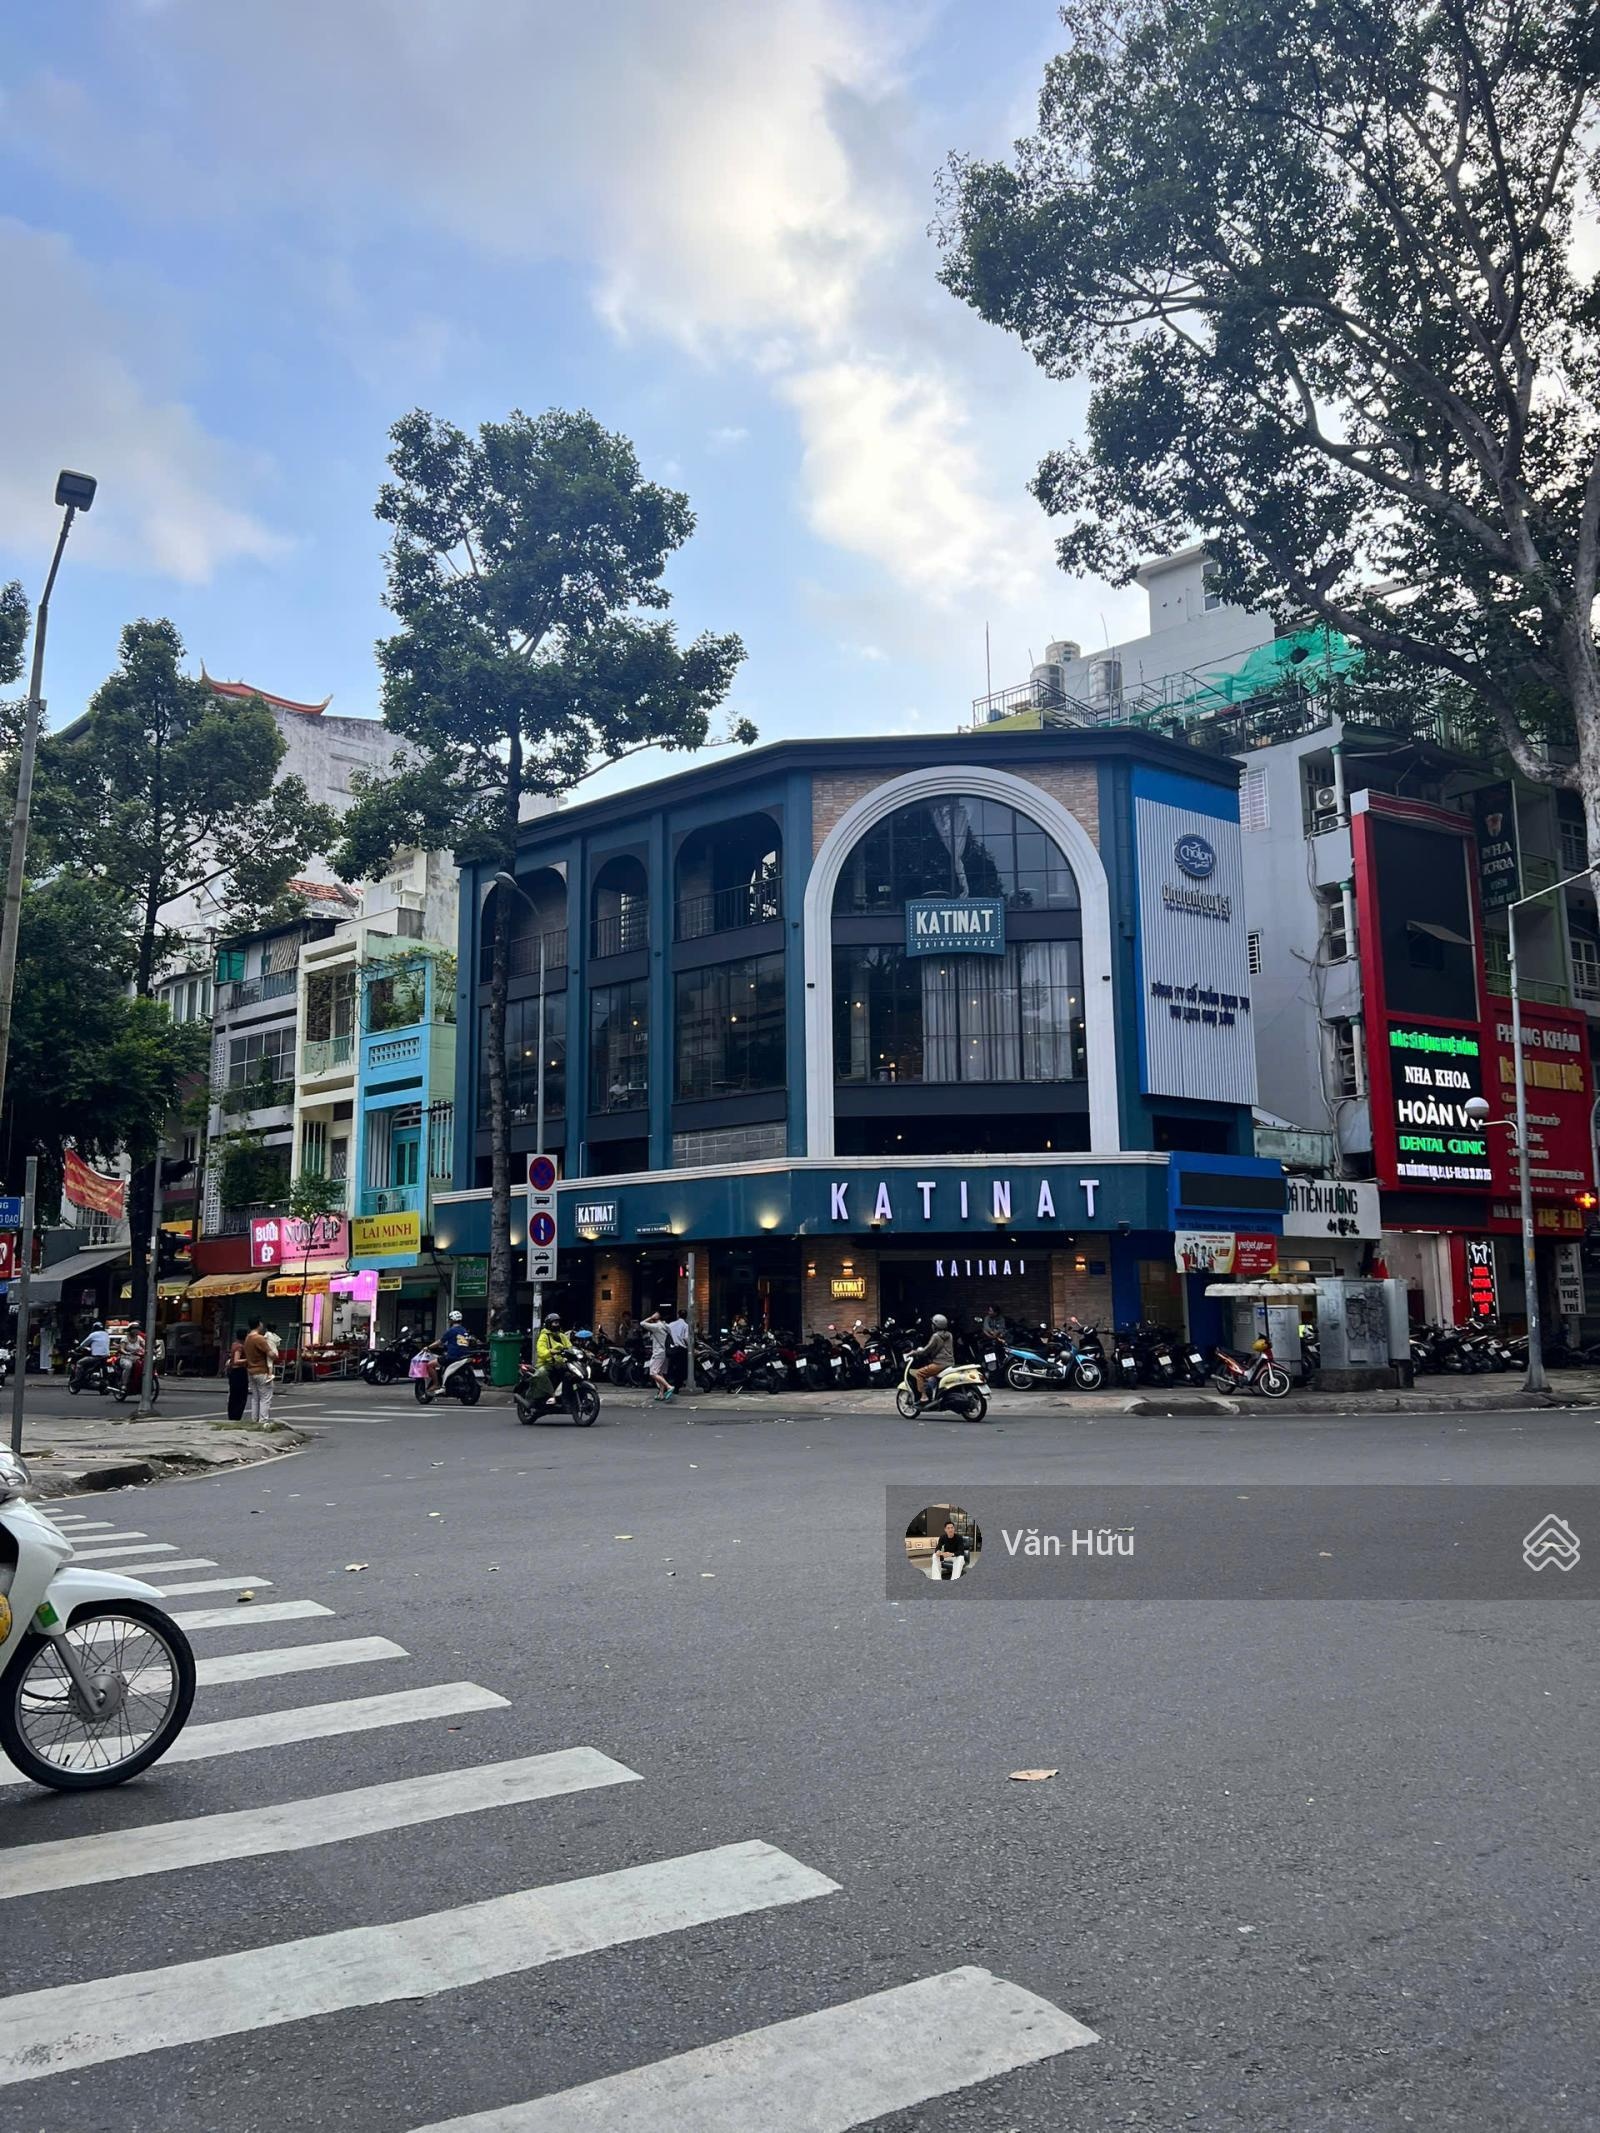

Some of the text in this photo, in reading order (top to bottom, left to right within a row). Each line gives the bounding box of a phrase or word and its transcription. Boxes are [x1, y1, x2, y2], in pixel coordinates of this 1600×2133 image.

[916, 909, 994, 934] KATINAT
[1496, 1023, 1541, 1047] PHNG
[1404, 1065, 1471, 1089] NHA KHOA
[1398, 1094, 1452, 1127] HOÀN
[1400, 1135, 1446, 1153] DENTAL
[1447, 1137, 1487, 1156] CLINIC
[831, 1179, 1099, 1220] KATINAT
[578, 1205, 614, 1223] KATINAT
[383, 1223, 412, 1237] MINH
[834, 1281, 863, 1293] KATINAT
